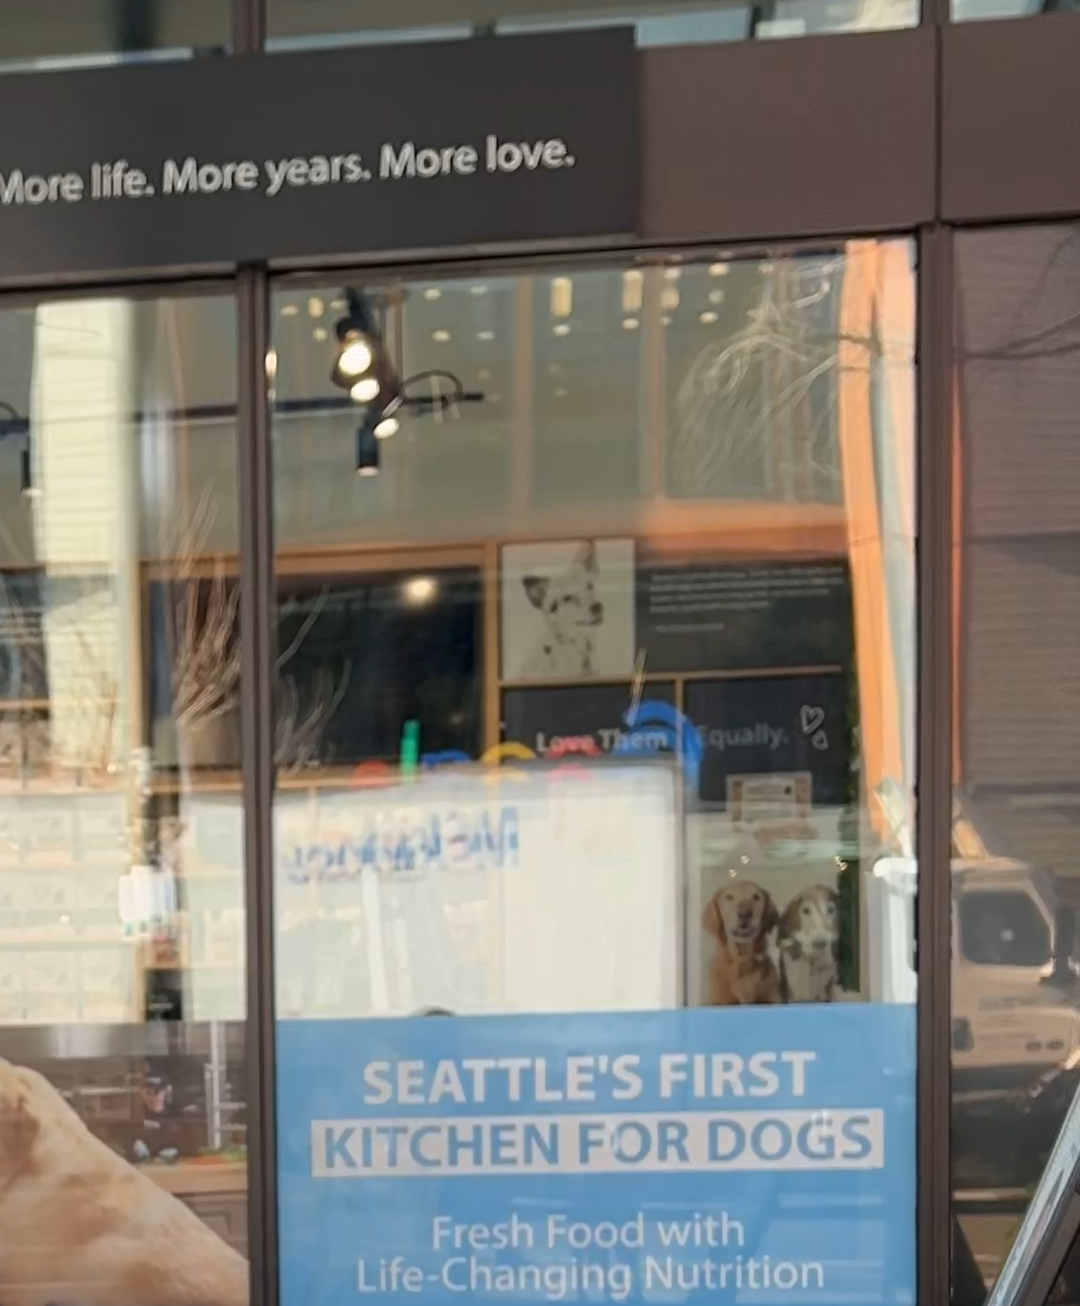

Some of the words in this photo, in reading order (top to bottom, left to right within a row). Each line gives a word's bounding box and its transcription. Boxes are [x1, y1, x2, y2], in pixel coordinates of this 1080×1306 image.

[91, 161, 155, 198] life.
[162, 157, 257, 194] More
[265, 151, 372, 196] years.
[380, 142, 478, 180] More
[486, 134, 576, 171] love.
[536, 730, 595, 752] Love
[597, 728, 668, 751] Them
[362, 1052, 642, 1106] SEATTLE'S
[659, 1050, 817, 1099] FIRST
[323, 1121, 560, 1169] KITCHEN
[578, 1119, 691, 1165] FOR
[707, 1115, 873, 1162] DOGS
[431, 1214, 534, 1252] Fresh
[547, 1212, 644, 1249] Food
[657, 1211, 745, 1248] with
[357, 1256, 633, 1301] Life-Changing
[645, 1255, 824, 1290] Nutrition
